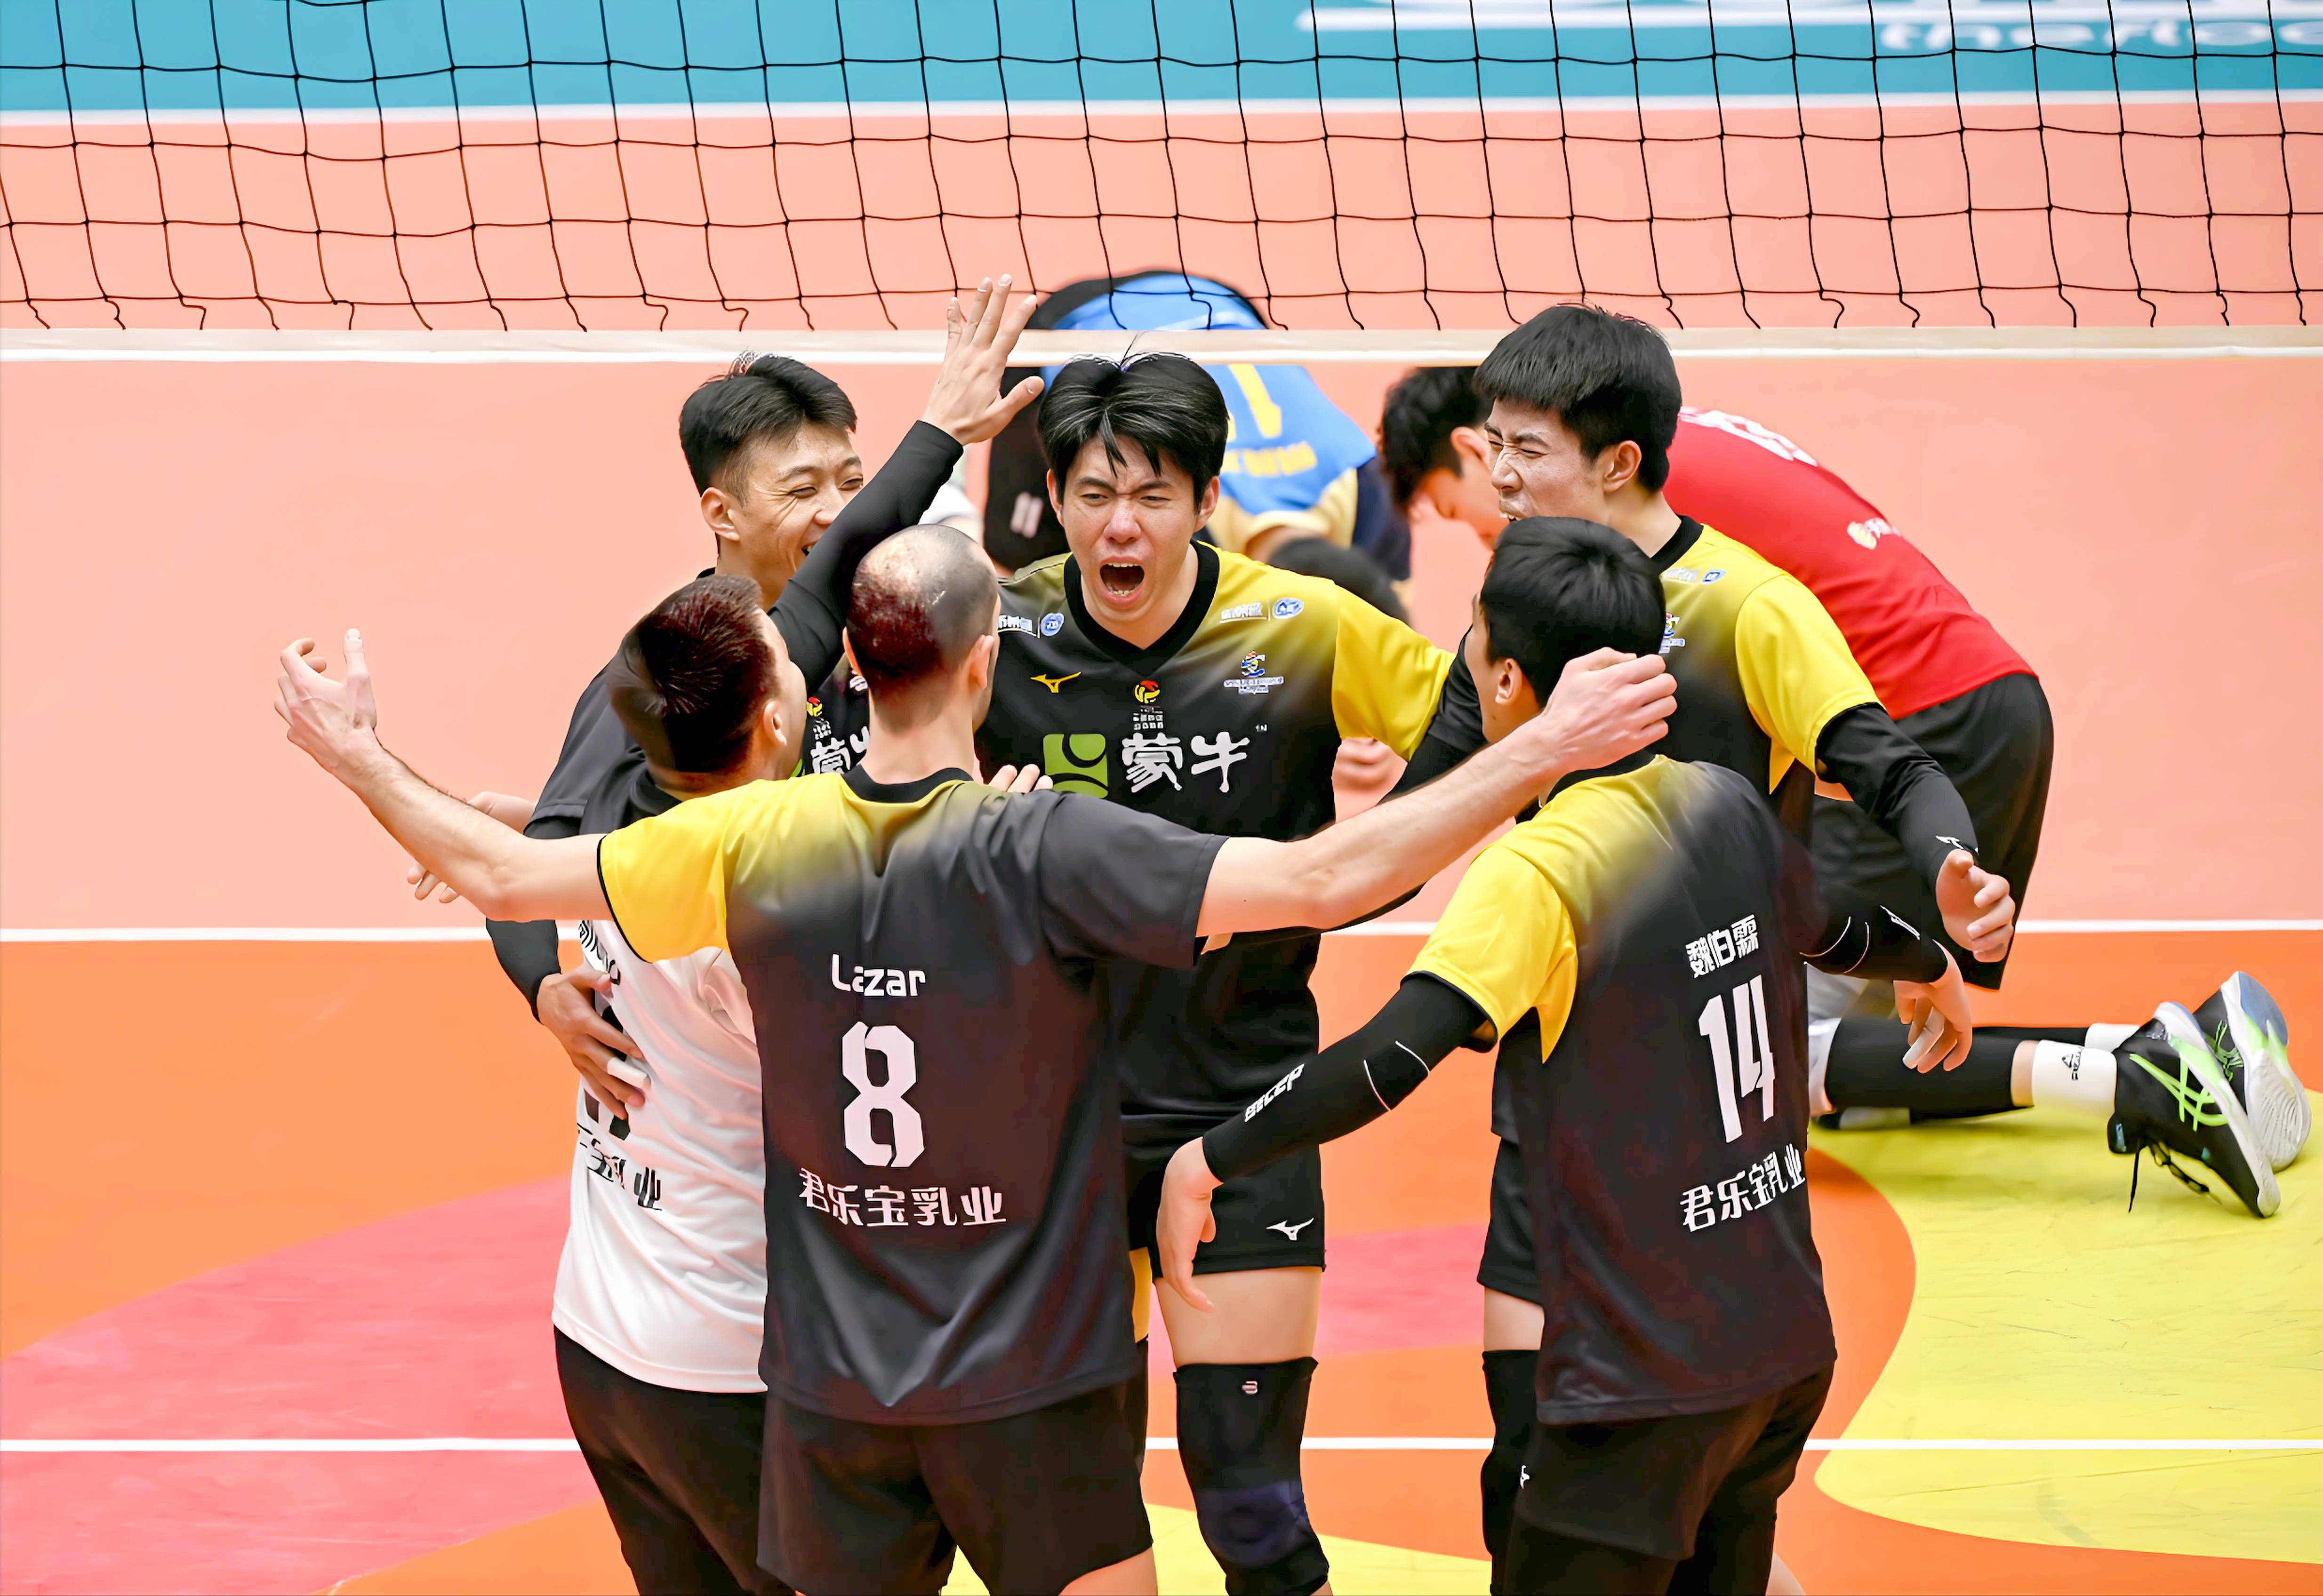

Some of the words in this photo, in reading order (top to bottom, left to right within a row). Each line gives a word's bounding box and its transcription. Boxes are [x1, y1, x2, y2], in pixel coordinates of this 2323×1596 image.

[1121, 731, 1250, 793] 蒙牛
[832, 954, 926, 996] Lazar
[842, 1021, 925, 1168] 8
[1698, 974, 1775, 1143] 14
[799, 1167, 1006, 1226] 君乐宝乳业
[1680, 1143, 1806, 1232] 君乐宝乳业
